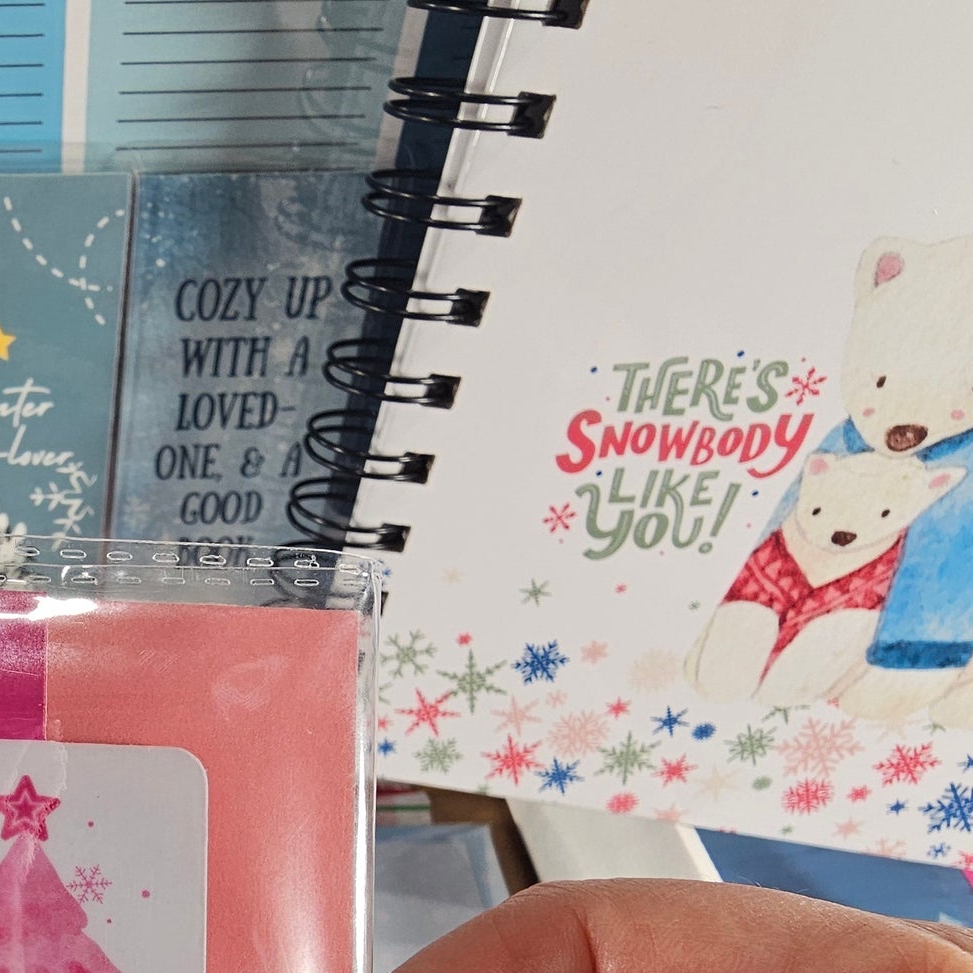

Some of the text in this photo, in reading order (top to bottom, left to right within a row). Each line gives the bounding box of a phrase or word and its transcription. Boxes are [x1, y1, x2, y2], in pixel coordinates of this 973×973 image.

[176, 275, 332, 321] COZY UP
[181, 335, 311, 377] WITH A
[613, 356, 789, 421] THERE'S
[176, 391, 296, 431] LOVED-
[155, 442, 303, 483] ONE, & A
[555, 409, 815, 479] SNOWBODY
[180, 490, 263, 525] GOOD
[608, 467, 720, 508] LIKE
[575, 482, 743, 561] YOU!
